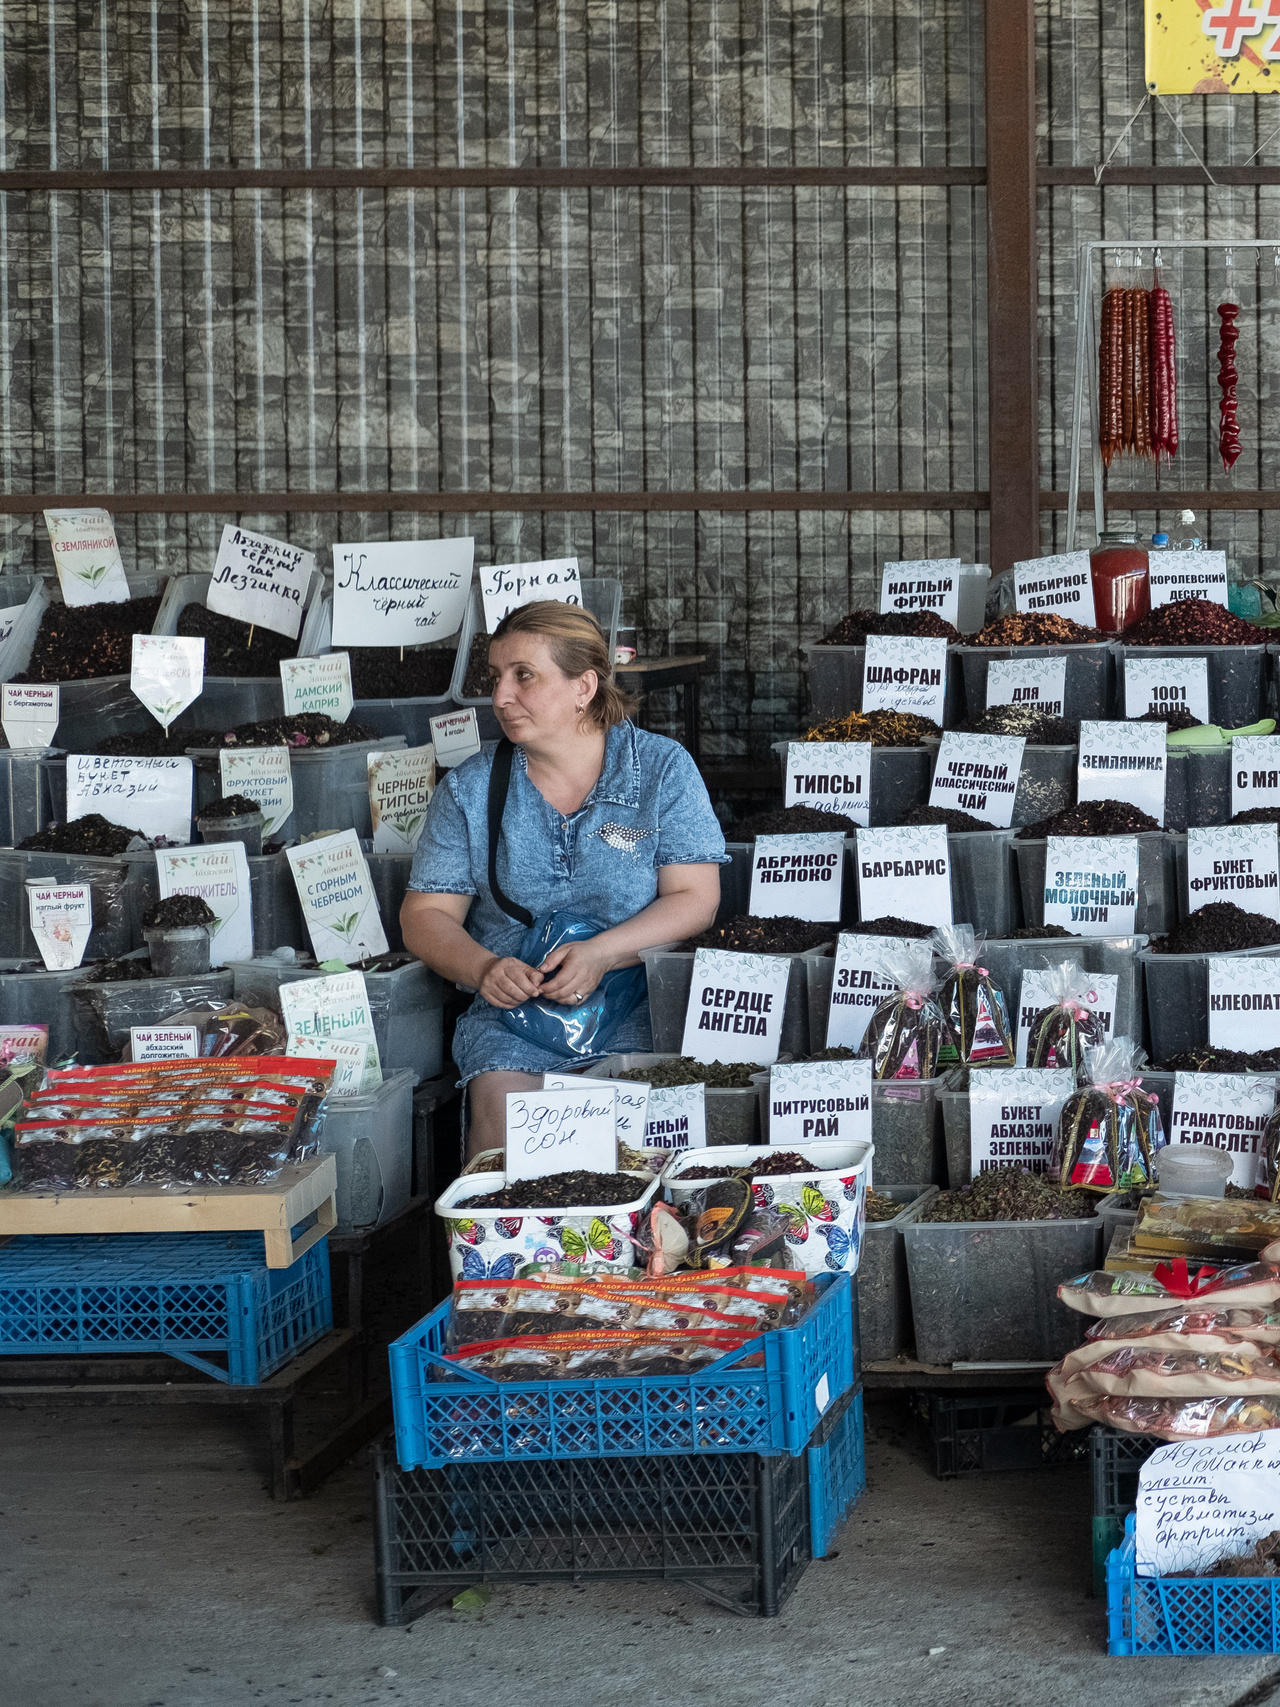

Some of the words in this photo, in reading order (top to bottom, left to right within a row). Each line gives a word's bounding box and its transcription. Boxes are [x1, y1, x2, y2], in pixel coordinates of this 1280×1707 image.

[54, 541, 61, 552] С
[62, 538, 115, 552] ЗЕМЛЯНИКОЙ
[246, 564, 273, 578] чай
[338, 554, 461, 592] Классический
[1150, 572, 1226, 585] КОРОЛЕВСКИЙ
[212, 567, 301, 604] Лезгинка
[485, 567, 580, 596] Горная
[888, 577, 953, 595] НАГЛЫЙ
[1018, 573, 1088, 596] ИМБИРНОЕ
[893, 594, 946, 609] ФРУКТ
[1028, 590, 1081, 609] ЯБЛОКО
[1169, 589, 1208, 601] ДЕСЕРТ
[374, 594, 429, 616] чёрный
[414, 611, 442, 628] чай
[867, 667, 941, 686] ШАФРАН
[8, 690, 22, 698] ЧАЙ
[24, 689, 53, 698] ЧЕРНЫЙ
[294, 682, 343, 699] ДАМСКИЙ
[1012, 687, 1039, 703] ДЛЯ
[1151, 685, 1187, 701] 1001
[14, 699, 53, 708] бергамотом
[301, 697, 340, 711] КАПРИЗ
[1148, 702, 1190, 715] НОЧЬ
[948, 762, 1008, 780] ЧЕРНЫЙ
[1082, 754, 1163, 771] ЗЕМЛЯНИКА
[226, 776, 288, 788] ФРУКТОВЫЙ
[377, 776, 426, 795] ЧЕРНЫЕ
[794, 775, 861, 794] ТИПСЫ
[935, 777, 1015, 793] КЛАССИЧЕСКИЙ
[1237, 771, 1248, 788] С
[243, 787, 273, 797] БУКЕТ
[377, 791, 429, 810] ТИПСЫ
[257, 797, 282, 808] АЗИИ
[957, 792, 987, 810] ЧАЙ
[757, 854, 838, 870] АБРИКОС
[862, 859, 946, 878] БАРБАРИС
[1213, 859, 1254, 875] БУКЕТ
[760, 868, 832, 883] ЯБЛОКО
[1055, 870, 1126, 888] ЗЕЛЕНЫЙ
[1190, 871, 1278, 891] ФРУКТОВЫЙ
[171, 883, 237, 898] ДОЛГОЖИТЕЛЬ
[308, 885, 315, 896] С
[316, 873, 357, 893] ГОРНЫМ
[36, 892, 50, 900] ЧАЙ
[52, 890, 84, 900] ЧЕРНЫЙ
[310, 885, 363, 910] ЧЕБРЕЦОМ
[1045, 887, 1135, 906] МОЛОЧНЫЙ
[63, 902, 85, 911] фрукт
[1071, 906, 1108, 922] УЛУН
[701, 987, 773, 1014] СЕРДЦЕ
[295, 1007, 365, 1035] ЗЕЛЕНЫЙ
[698, 1011, 767, 1036] АНГЕЛА
[136, 1032, 152, 1042] ЧАЙ
[154, 1031, 192, 1042] ЗЕЛЁНЫЙ
[140, 1051, 190, 1061] долгожитель
[772, 1094, 869, 1117] ЦИТРУСОВЫЙ
[1001, 1106, 1042, 1121] БУКЕТ
[803, 1115, 840, 1138] РАЙ
[1172, 1111, 1269, 1132] ГРАНАТОВЫЙ
[990, 1124, 1053, 1138] АБХАЗИИ
[989, 1139, 1053, 1156] ЗЕЛЕНЫЙ
[1180, 1130, 1261, 1154] БРАСЛЕТ
[980, 1159, 1050, 1173] ЦВЕТОЧНЫ
[1143, 1489, 1232, 1512] суставы
[1157, 1508, 1274, 1529] ревматизм
